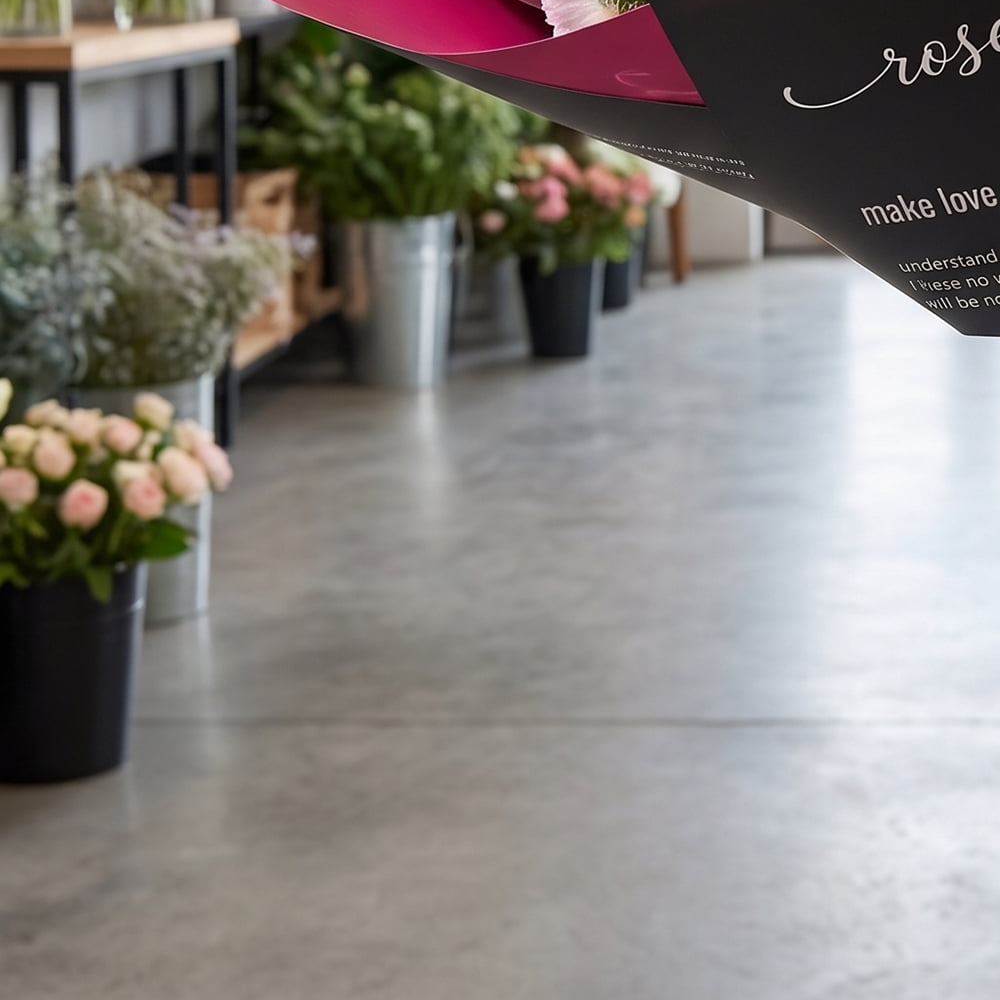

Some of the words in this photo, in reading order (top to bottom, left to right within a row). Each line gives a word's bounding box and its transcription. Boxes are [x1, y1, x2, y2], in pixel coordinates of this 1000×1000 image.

[860, 195, 936, 225] make
[937, 186, 997, 214] love
[899, 249, 998, 272] understand
[965, 276, 989, 288] no
[925, 297, 953, 310] will
[955, 296, 980, 309] be
